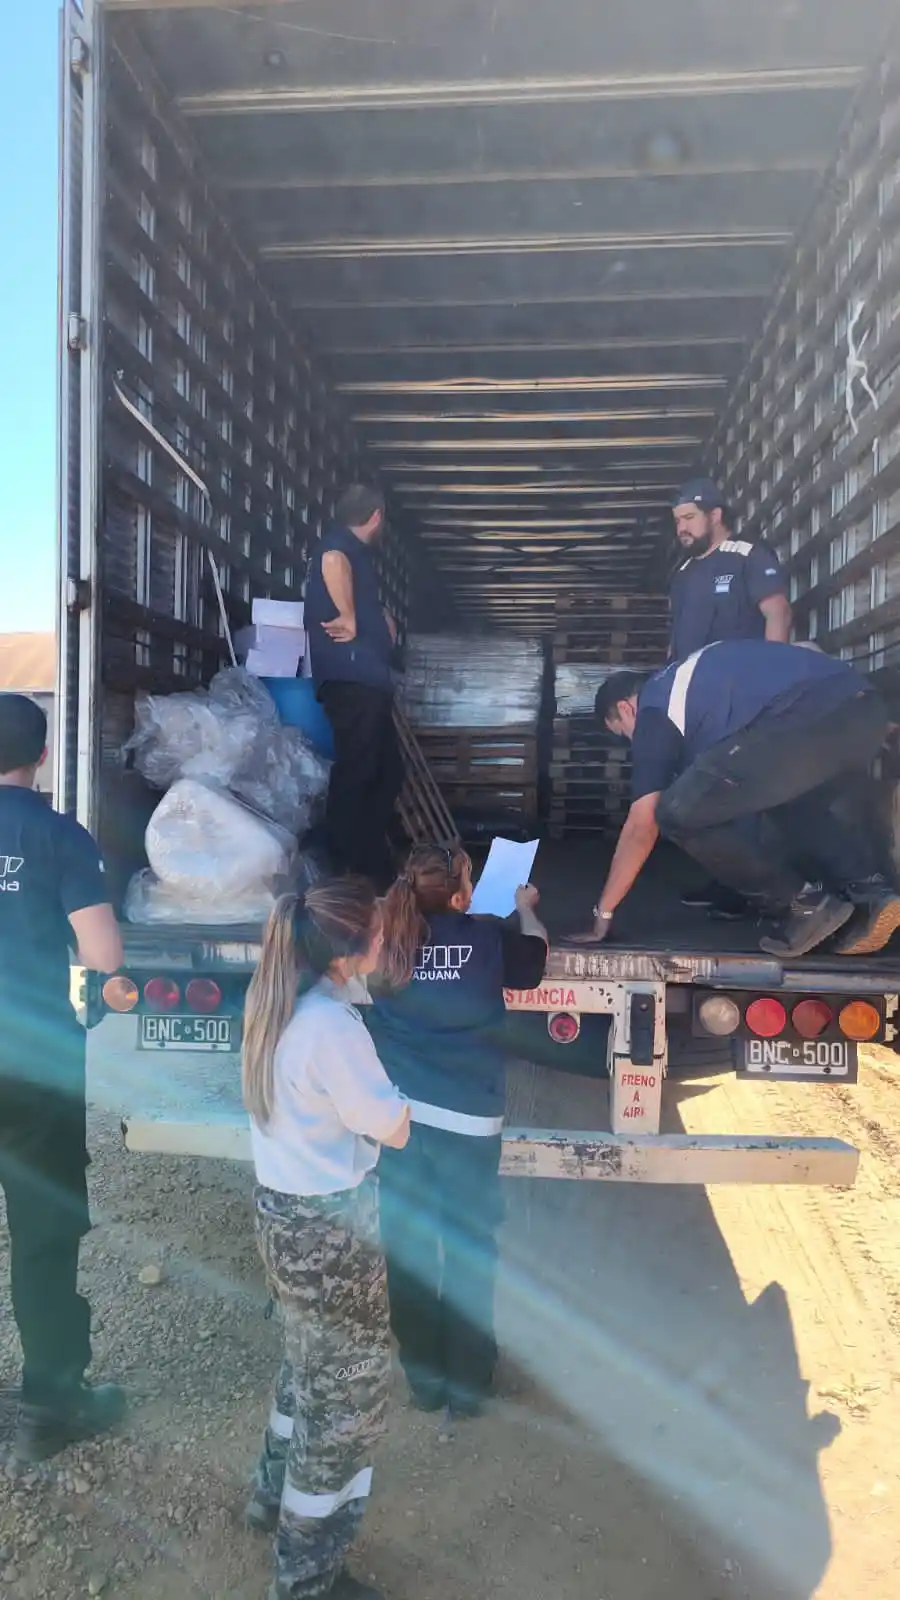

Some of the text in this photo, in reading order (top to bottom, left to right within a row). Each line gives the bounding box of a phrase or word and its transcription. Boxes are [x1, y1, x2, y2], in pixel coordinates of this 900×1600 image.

[412, 970, 461, 981] ADUANA
[146, 1018, 182, 1041] BNC
[194, 1019, 230, 1042] 500
[750, 1040, 791, 1065] BNC
[803, 1041, 843, 1066] 500
[621, 1074, 656, 1088] FRENO
[633, 1090, 640, 1103] A
